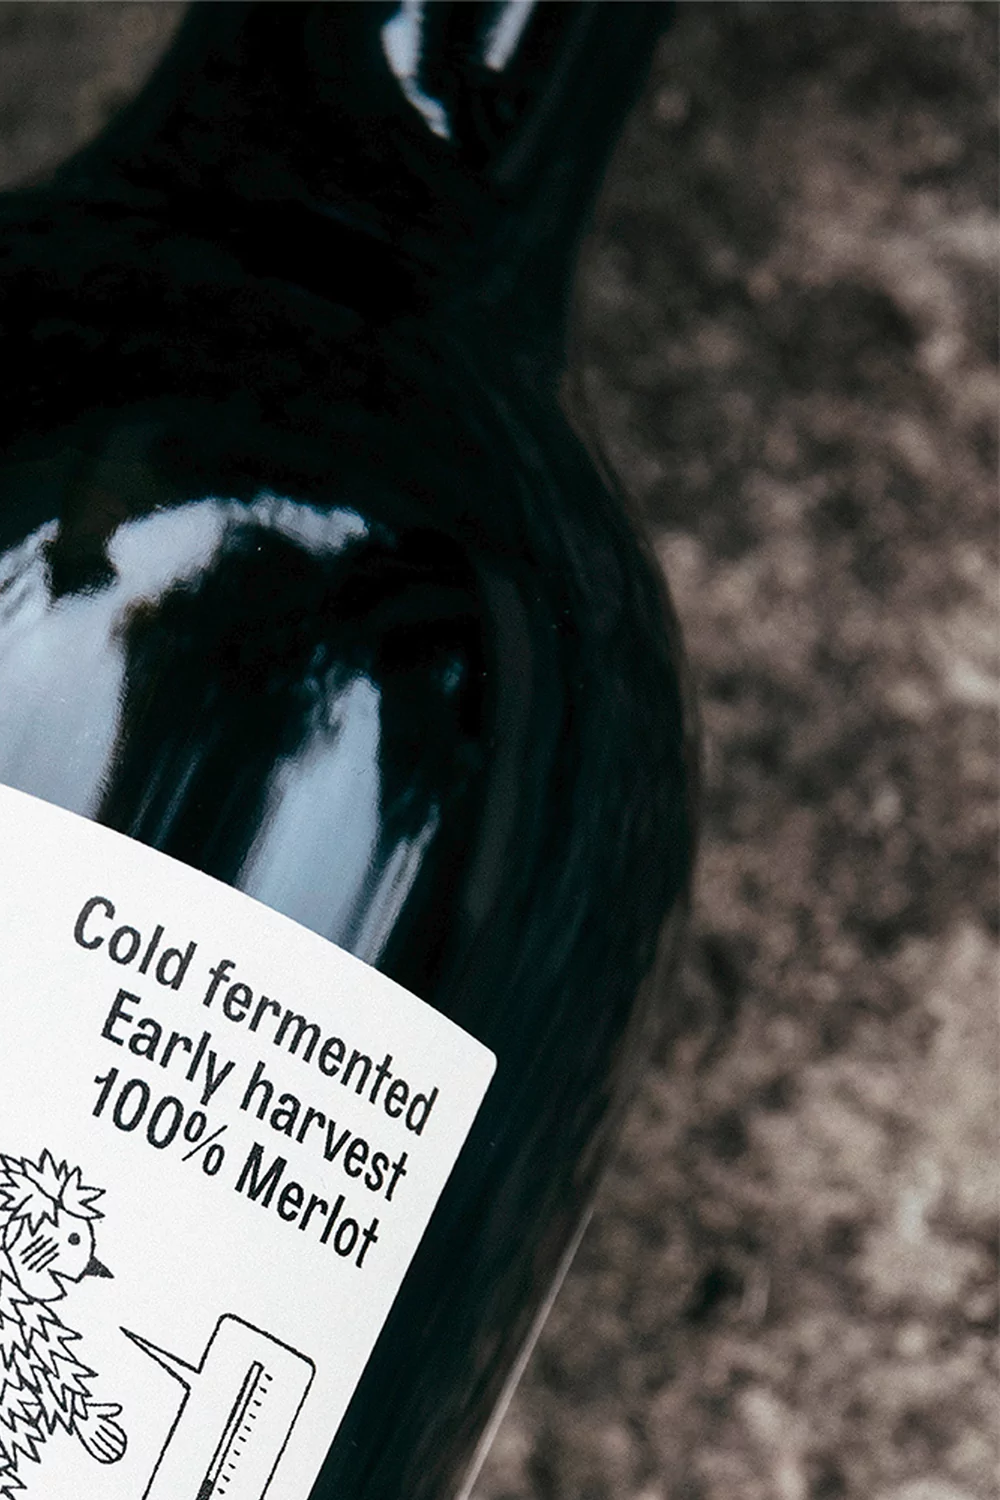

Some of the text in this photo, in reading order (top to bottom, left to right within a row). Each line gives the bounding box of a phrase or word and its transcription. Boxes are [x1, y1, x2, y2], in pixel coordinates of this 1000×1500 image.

[74, 896, 439, 1136] Cold fermented
[101, 988, 408, 1202] Early harvest
[92, 1067, 379, 1268] 100% Merlot
